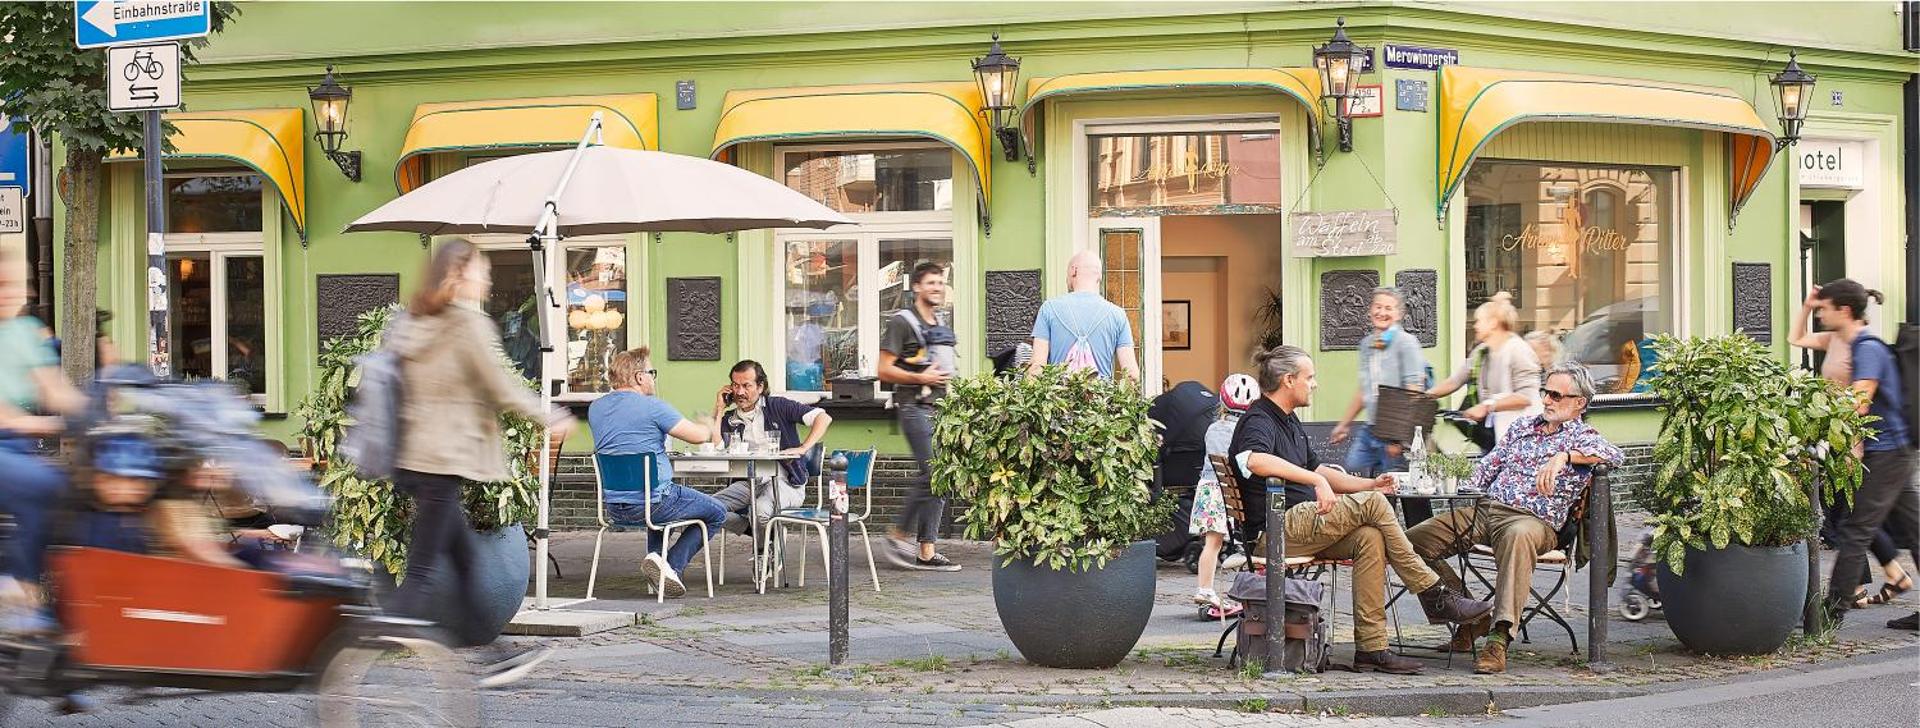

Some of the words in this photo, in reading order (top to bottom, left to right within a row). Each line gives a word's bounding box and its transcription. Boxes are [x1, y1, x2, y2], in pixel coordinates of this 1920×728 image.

[113, 1, 201, 20] Einbahnstraße
[1298, 212, 1380, 240] Waffeln
[1296, 236, 1318, 248] am
[1582, 225, 1632, 256] Ritter
